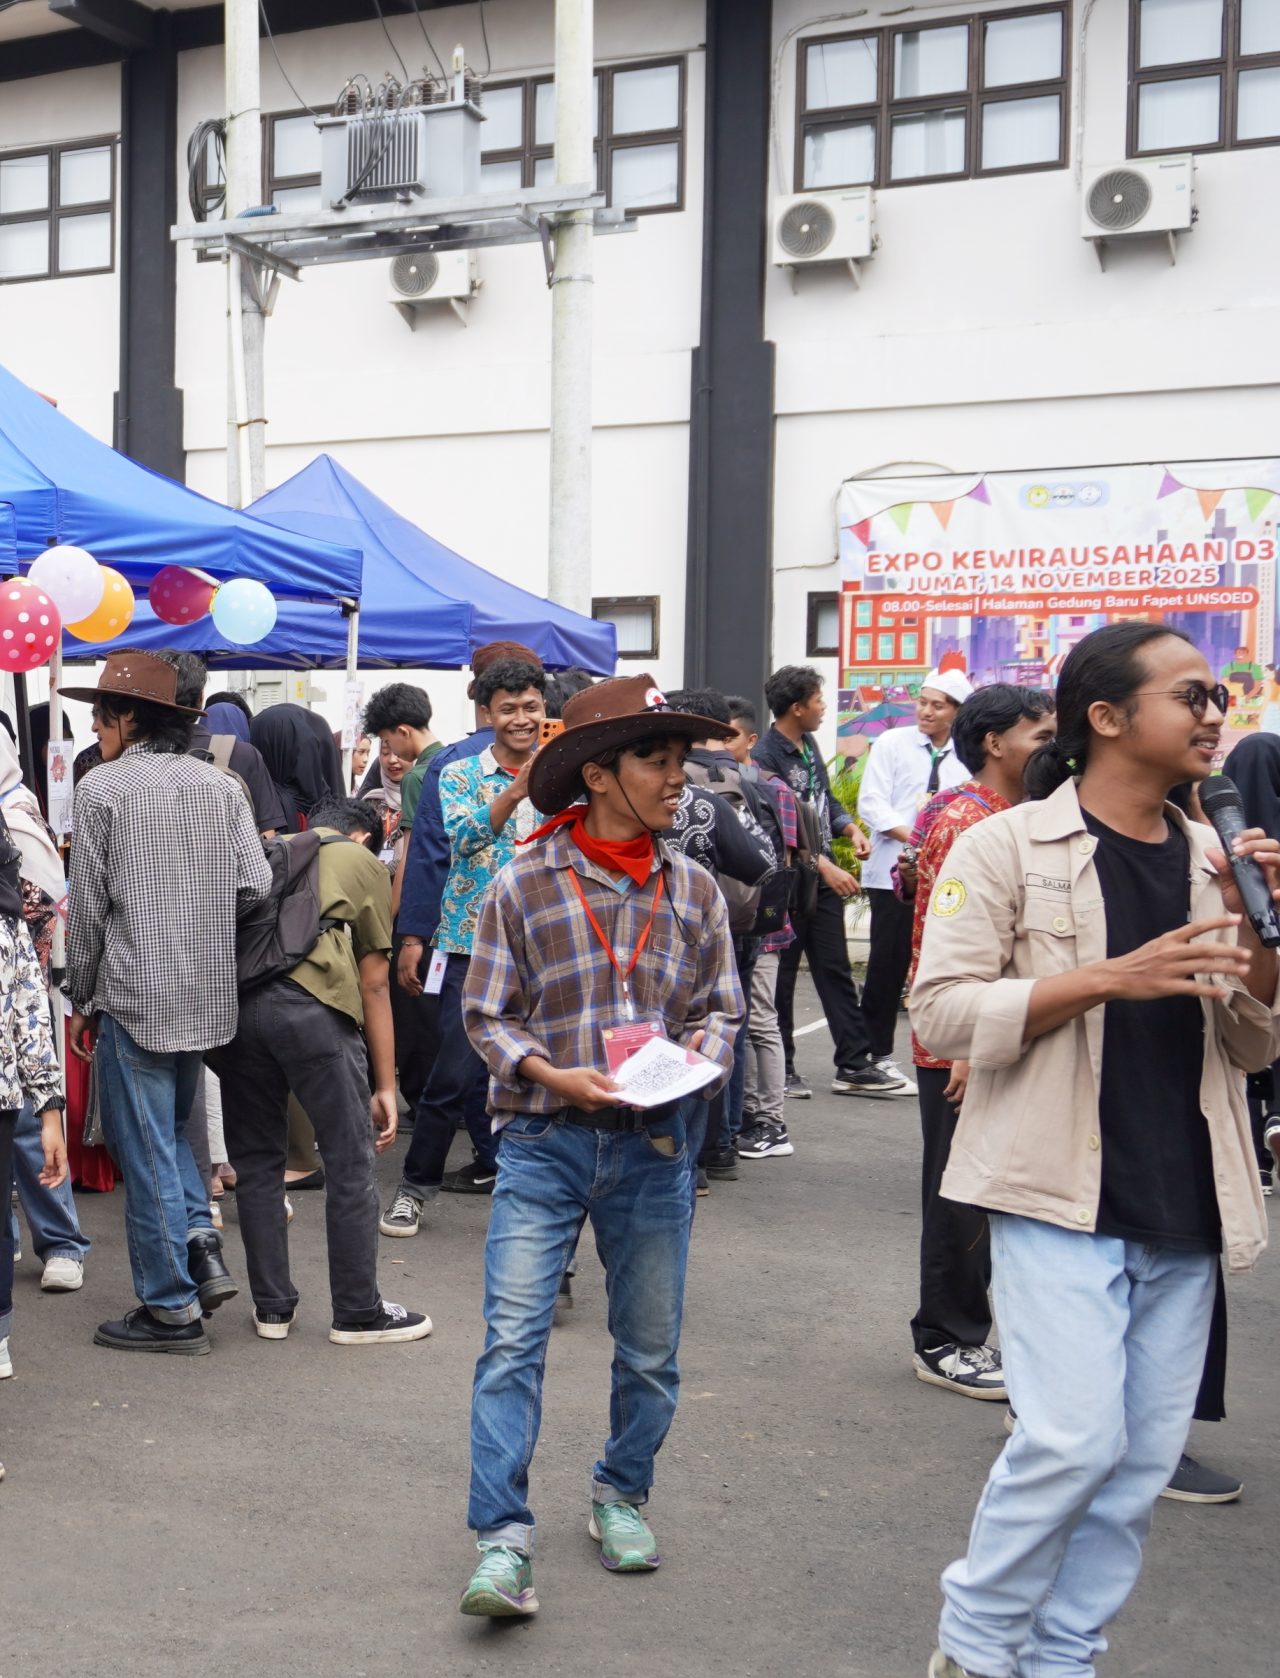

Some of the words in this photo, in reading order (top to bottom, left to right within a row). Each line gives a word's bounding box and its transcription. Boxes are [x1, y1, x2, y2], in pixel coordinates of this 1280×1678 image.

[868, 551, 943, 573] EXPO
[952, 541, 1224, 571] KEWIRAUSAHAAN
[1234, 539, 1275, 561] D3
[907, 575, 985, 592] JUMAT,
[991, 574, 1014, 589] 14
[1022, 569, 1152, 589] NOVEMBER
[1160, 567, 1216, 585] 2025
[882, 600, 973, 612] 08.00-Selesai
[982, 598, 1044, 610] Halaman
[1047, 596, 1102, 610] Gedung
[1105, 595, 1139, 607] Baru
[1142, 594, 1183, 608] Fapet
[1186, 592, 1253, 605] UNSOED
